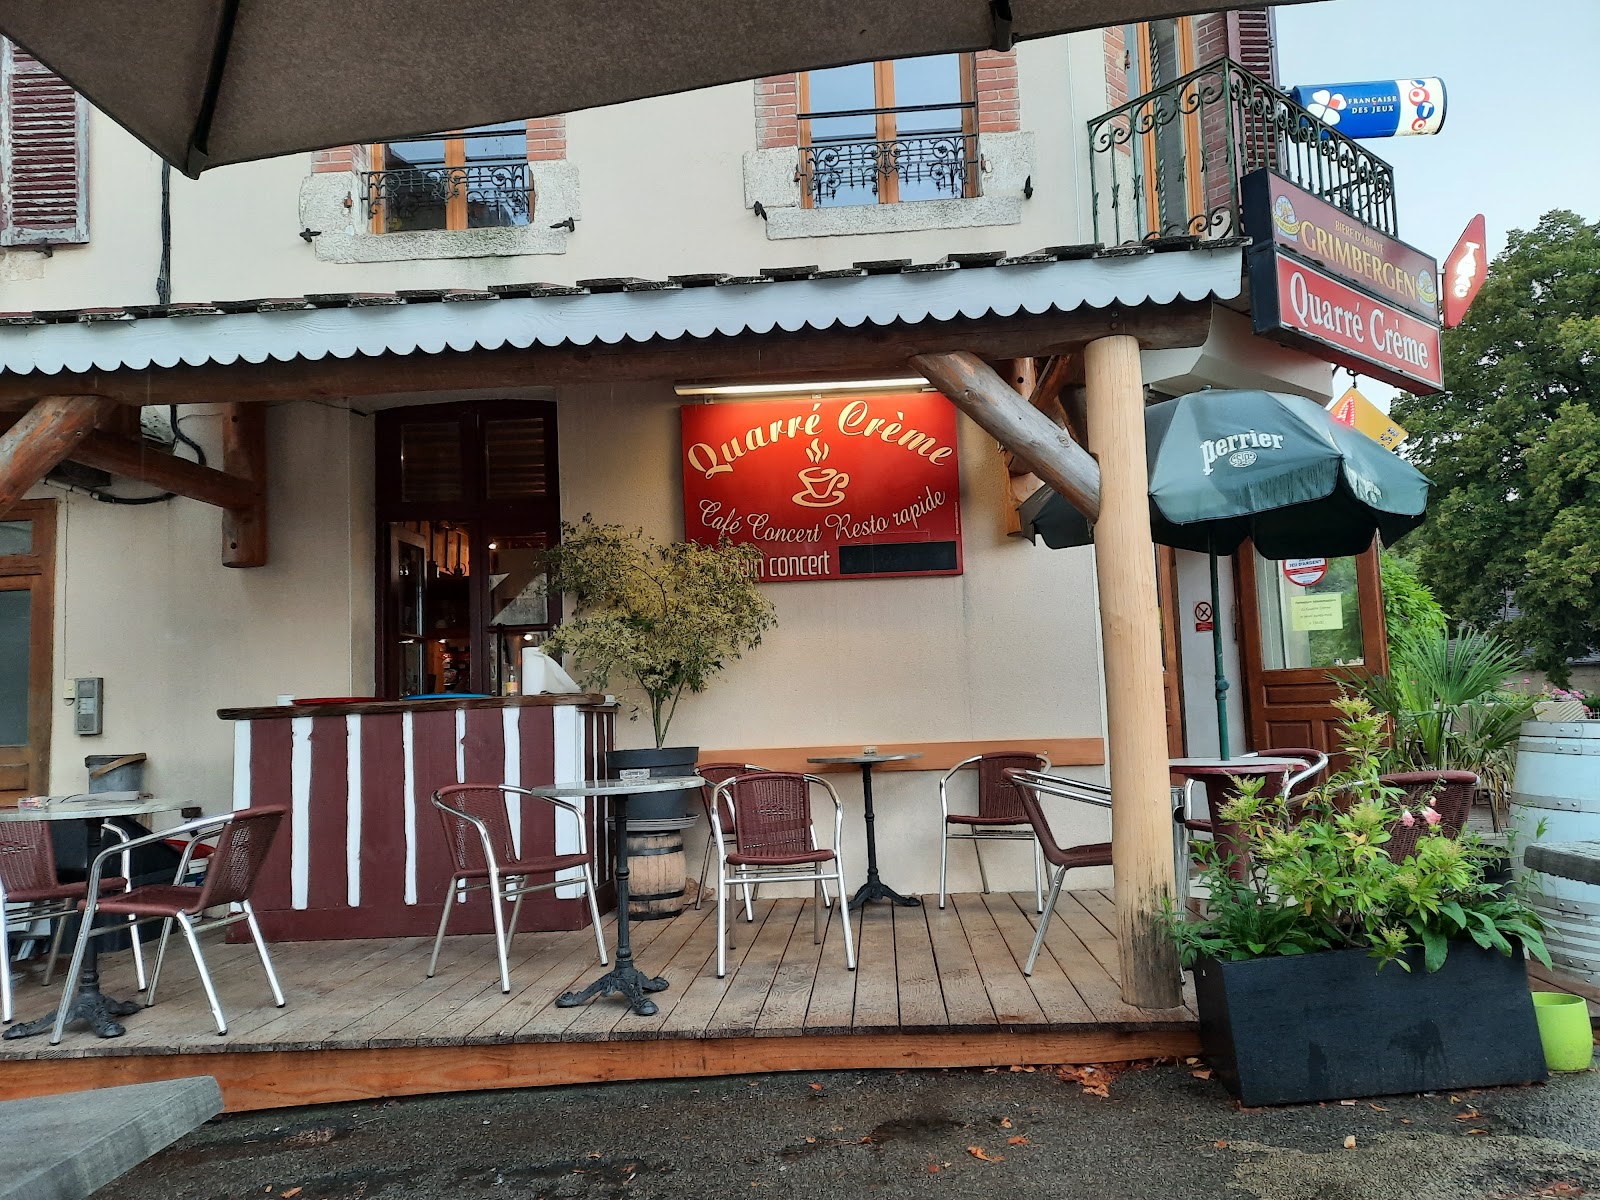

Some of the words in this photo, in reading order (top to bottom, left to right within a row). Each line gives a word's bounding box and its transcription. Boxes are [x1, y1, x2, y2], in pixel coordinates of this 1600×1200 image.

[1348, 95, 1398, 106] FRANÇAISE
[1352, 106, 1368, 114] DES
[1371, 105, 1394, 114] JEUX
[1300, 220, 1417, 300] GRIMBERGEN
[1290, 271, 1365, 343] Quarré
[1369, 308, 1430, 369] Crème
[687, 402, 824, 480] Quarré
[837, 400, 953, 466] Crème
[1200, 429, 1284, 476] perrier
[698, 499, 742, 538] Café
[746, 513, 824, 543] Concert
[824, 513, 891, 541] Resto
[892, 485, 945, 530] rapide
[769, 550, 830, 578] concert
